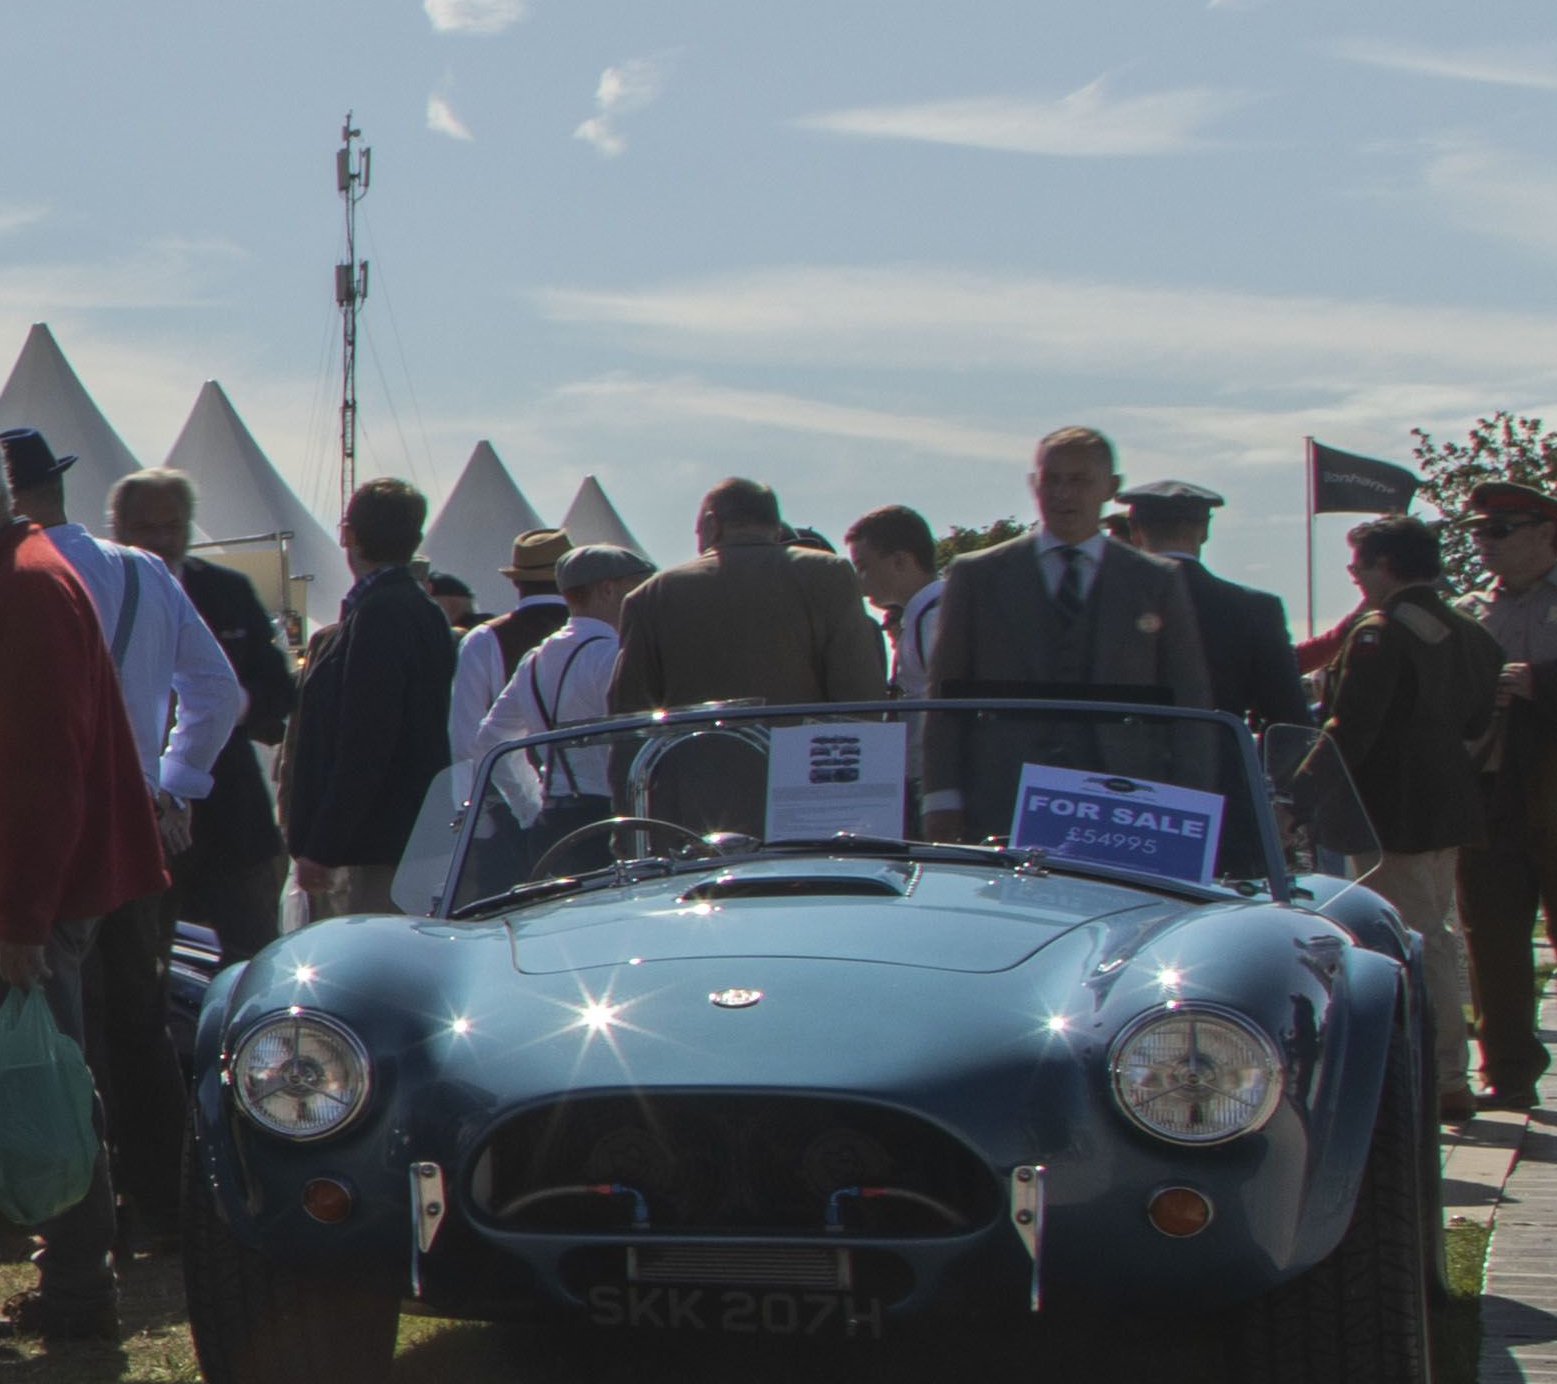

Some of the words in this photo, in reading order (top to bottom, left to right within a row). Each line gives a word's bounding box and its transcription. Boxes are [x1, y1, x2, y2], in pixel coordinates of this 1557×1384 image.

[1028, 795, 1101, 821] FOR
[1111, 806, 1204, 839] SALE
[1064, 826, 1158, 855] £54995
[588, 1285, 706, 1330] SKK
[720, 1290, 881, 1339] 207H
